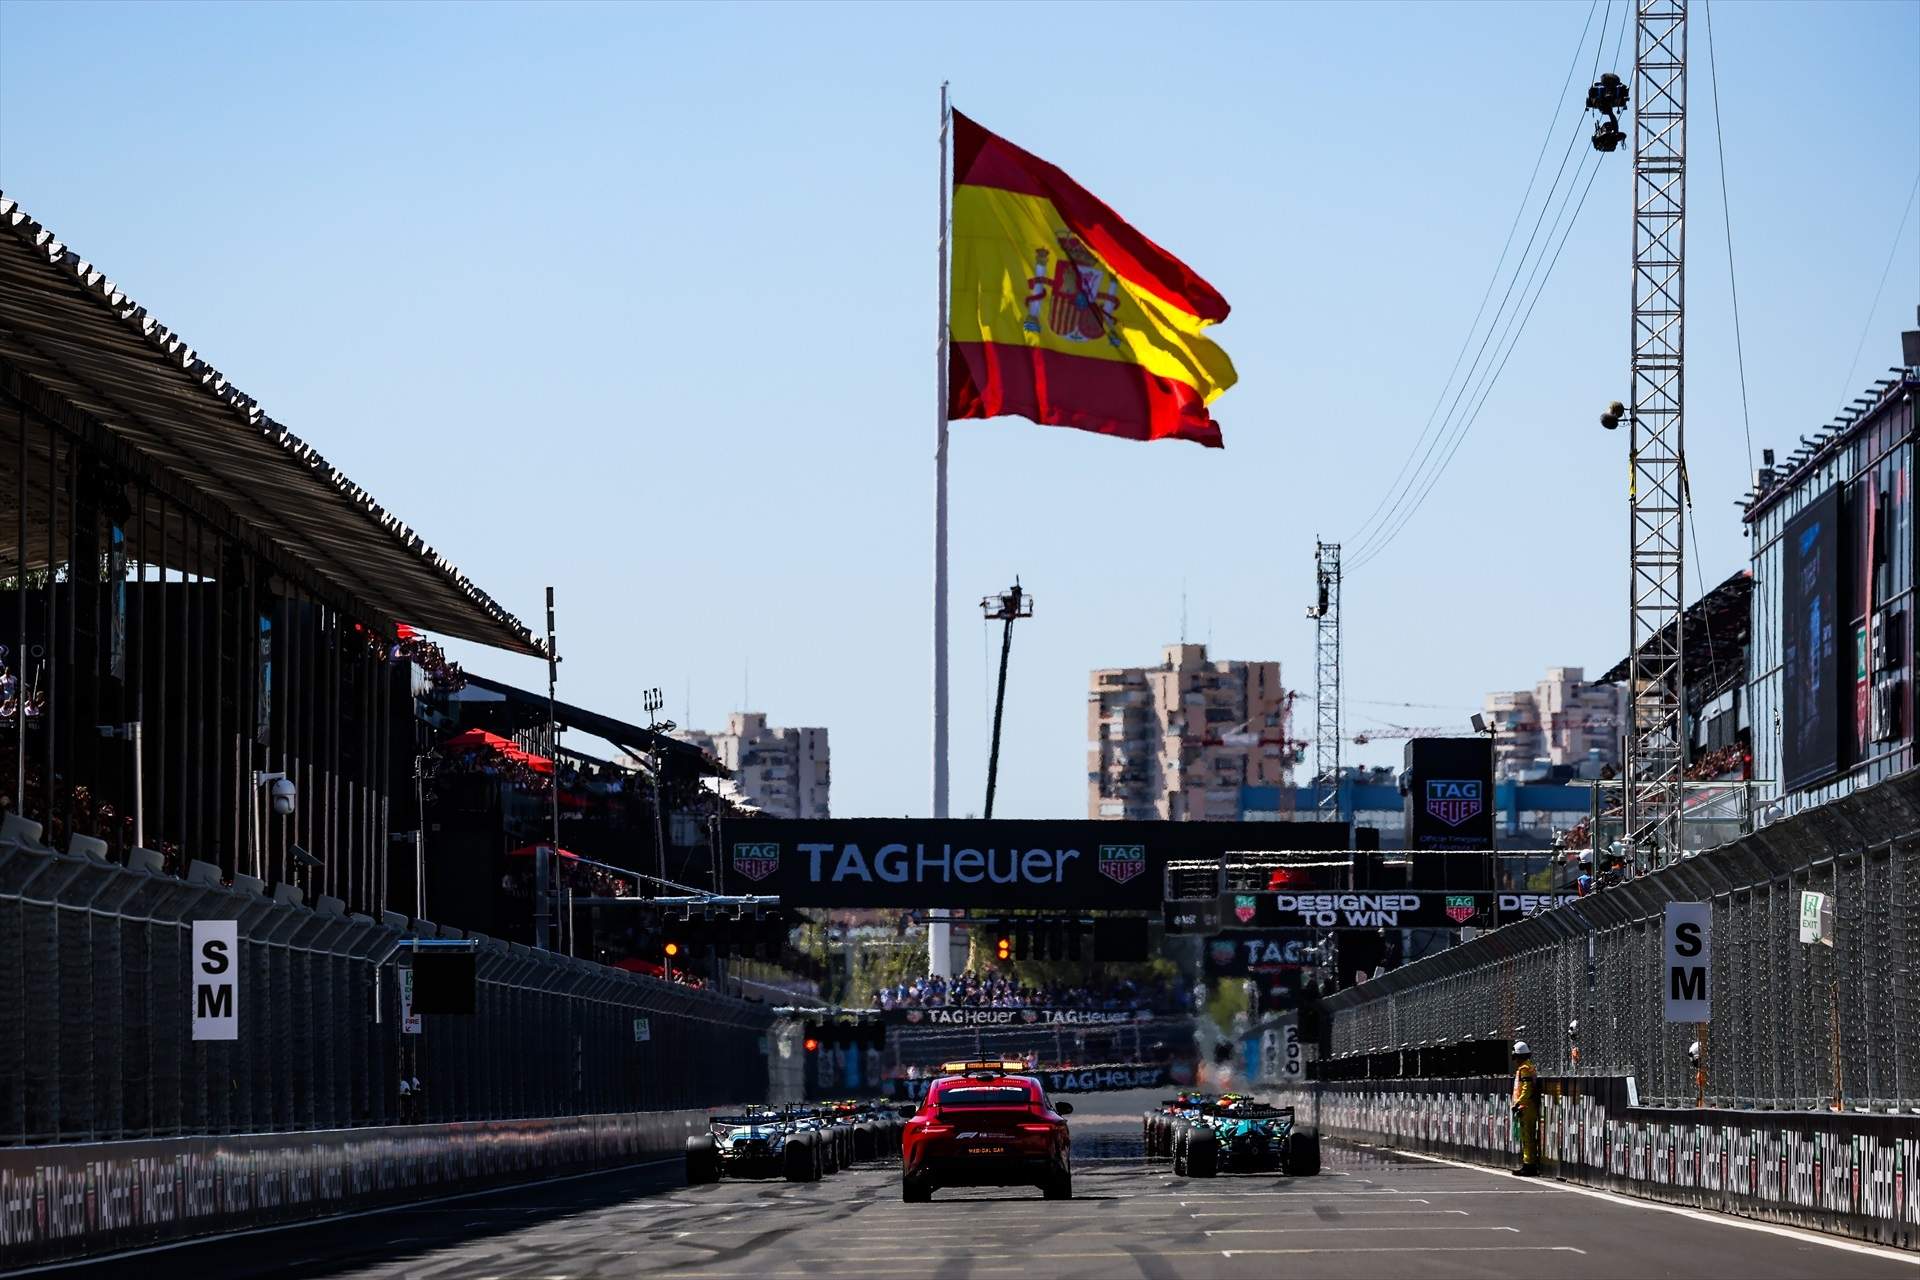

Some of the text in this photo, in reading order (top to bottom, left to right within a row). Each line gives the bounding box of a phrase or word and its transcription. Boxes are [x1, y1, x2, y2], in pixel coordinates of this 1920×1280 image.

[1431, 783, 1477, 798] TAG
[1429, 801, 1479, 823] HEUER
[737, 846, 775, 858] TAG
[1104, 847, 1141, 859] TAG
[736, 860, 777, 878] HEUER
[1102, 862, 1142, 881] HEUER
[1277, 894, 1421, 911] DESIGNED
[1448, 897, 1472, 906] TAG
[1298, 911, 1399, 927] TO WIN
[1803, 919, 1818, 929] EXIT
